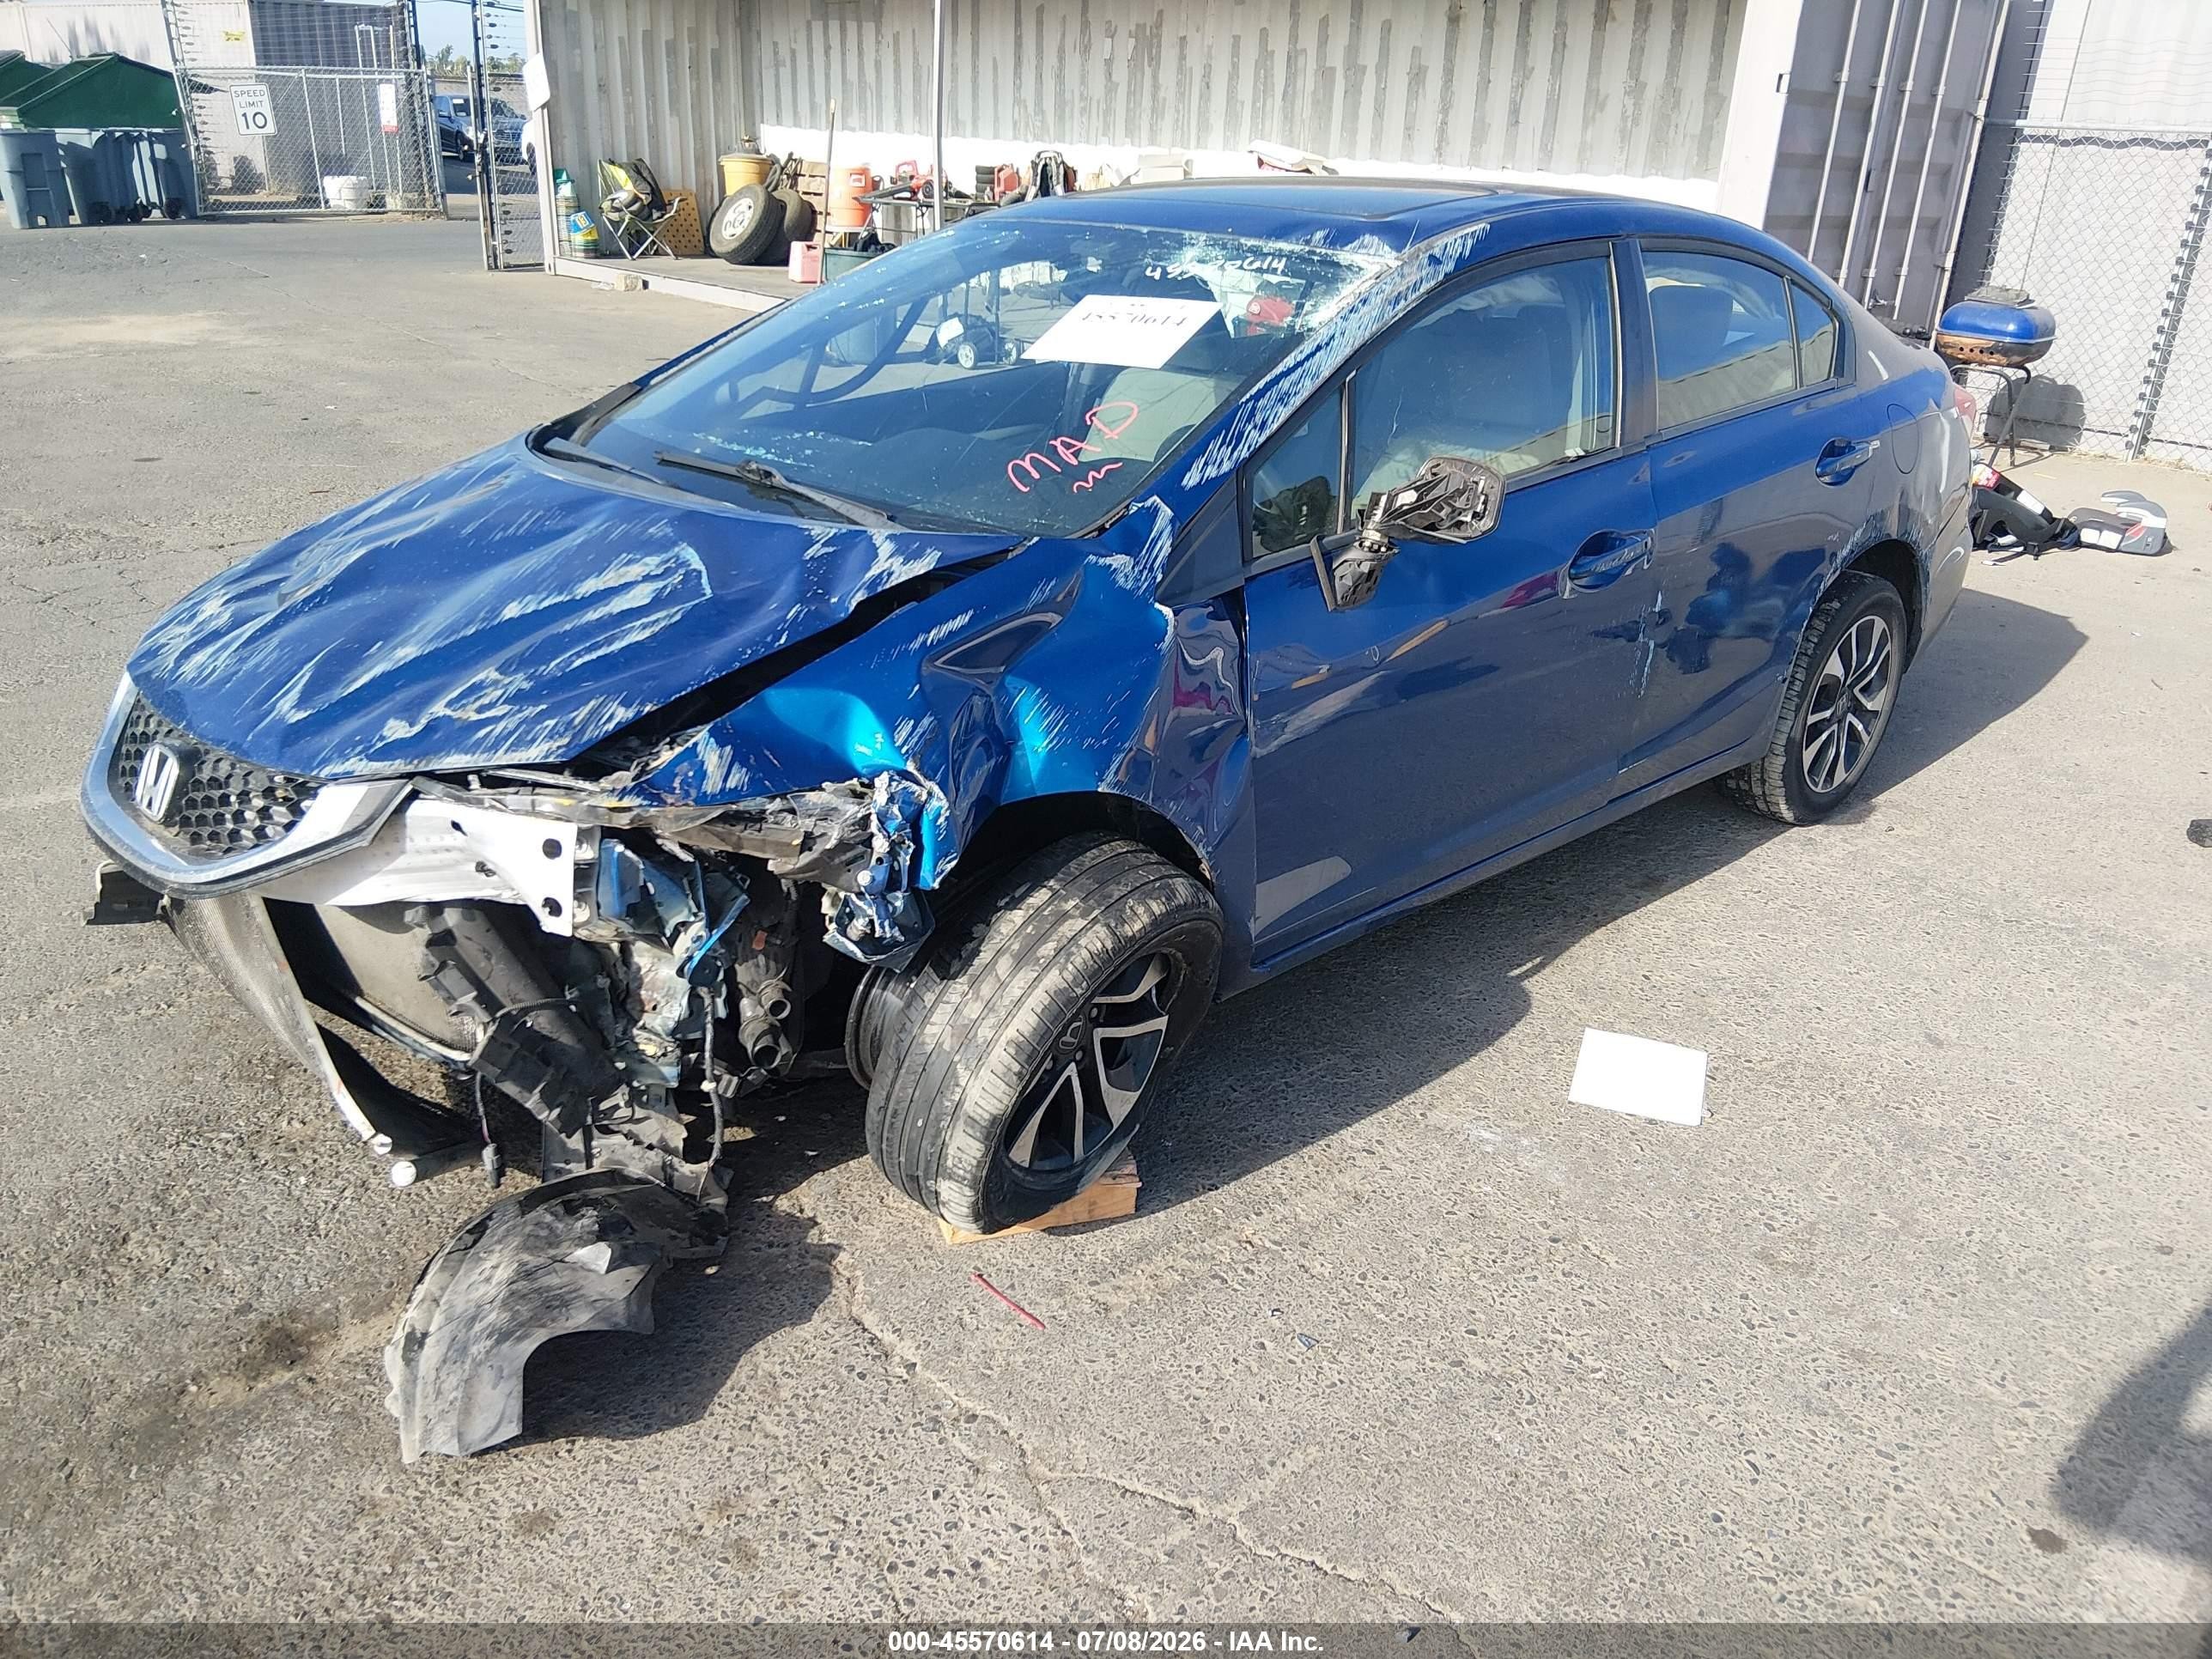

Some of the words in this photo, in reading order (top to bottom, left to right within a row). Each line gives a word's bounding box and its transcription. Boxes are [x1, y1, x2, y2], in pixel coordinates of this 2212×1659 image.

[233, 89, 265, 98] SPEED
[239, 100, 264, 109] LIMIT
[241, 112, 268, 130] 10
